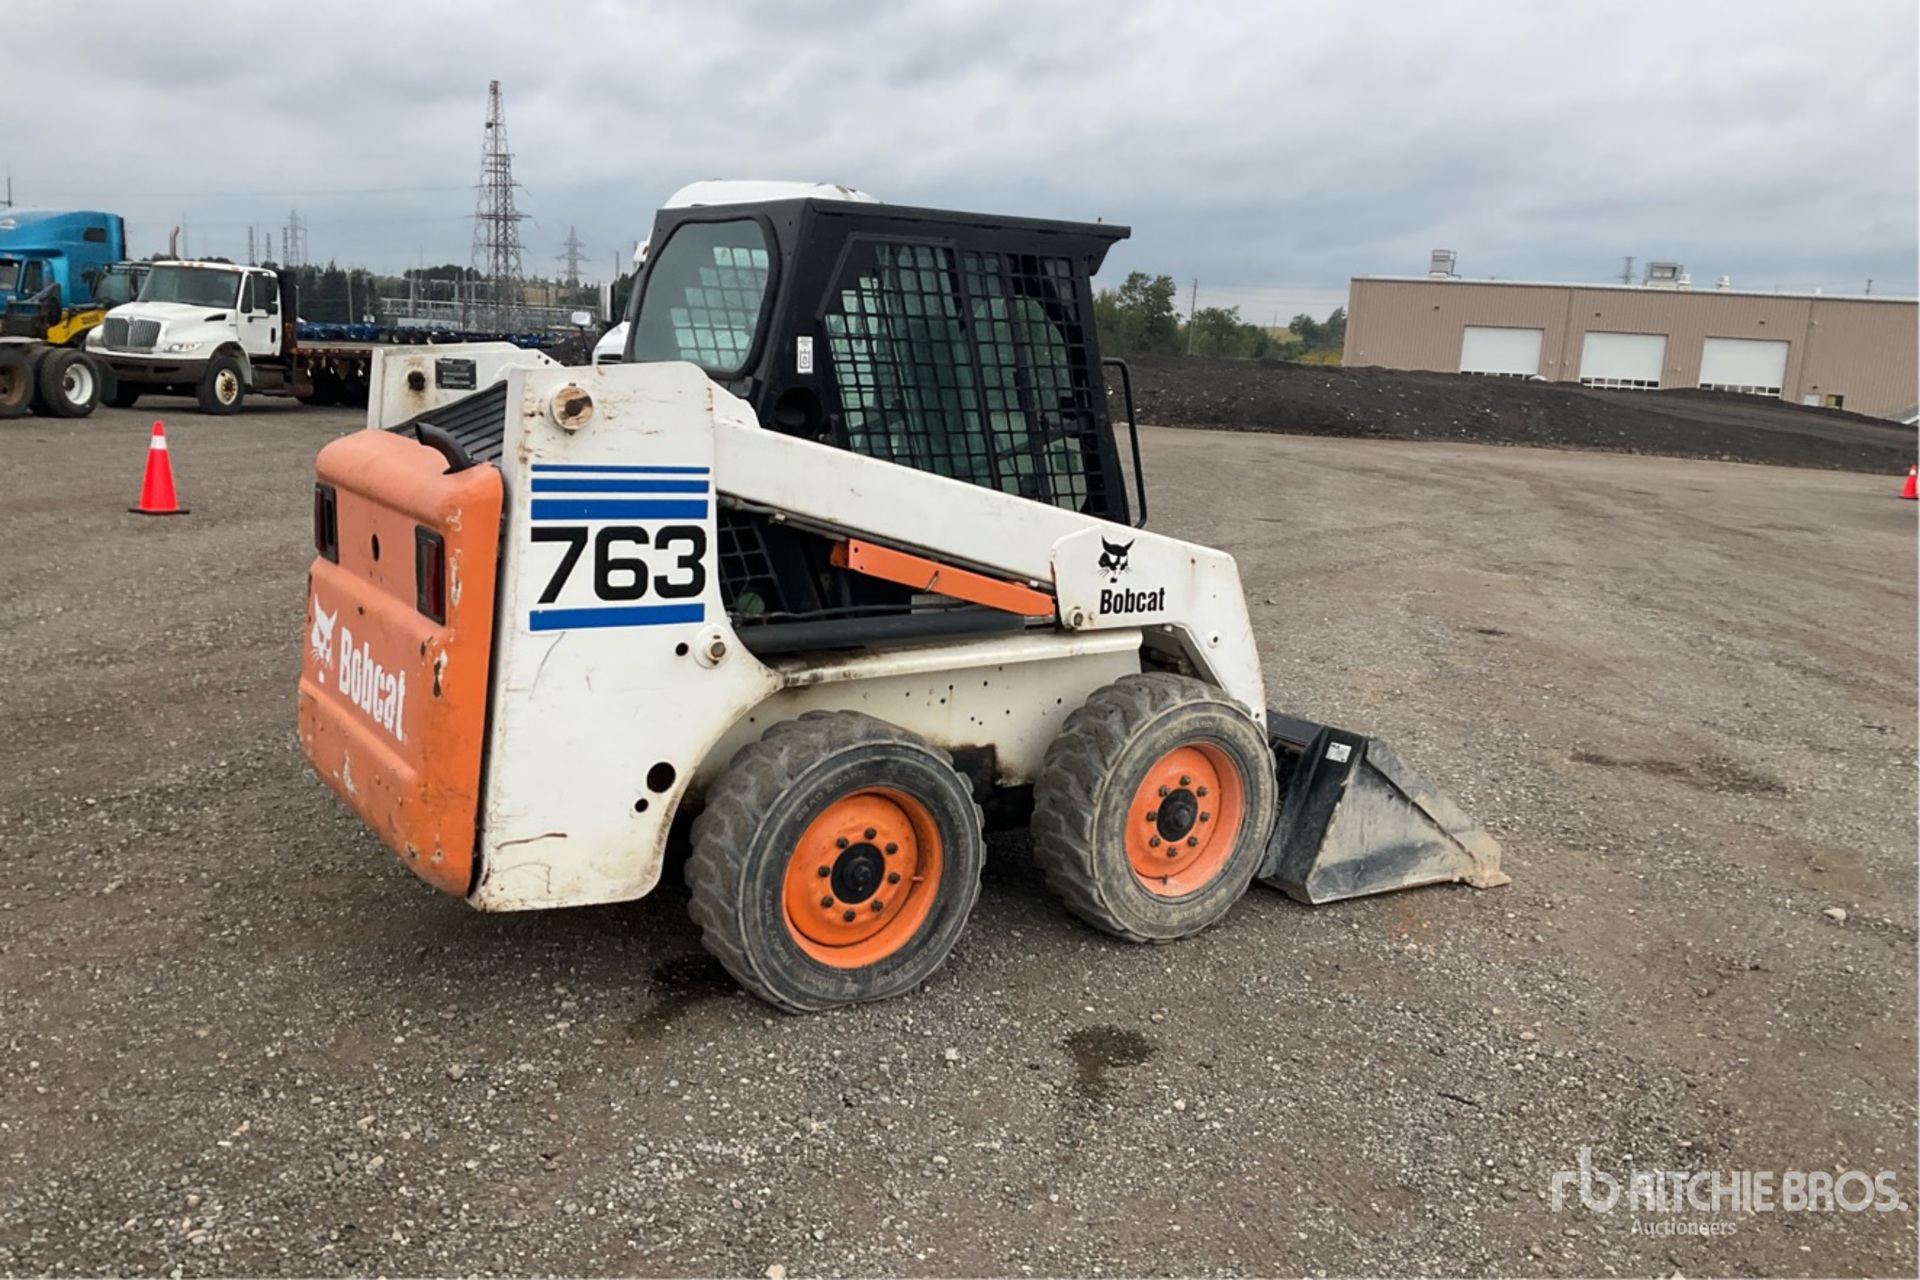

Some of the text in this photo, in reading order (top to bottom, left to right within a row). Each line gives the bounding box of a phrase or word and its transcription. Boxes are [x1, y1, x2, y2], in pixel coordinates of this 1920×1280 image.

[531, 525, 707, 604] 763
[1099, 587, 1165, 614] Bobcat
[338, 626, 406, 741] Bobcat
